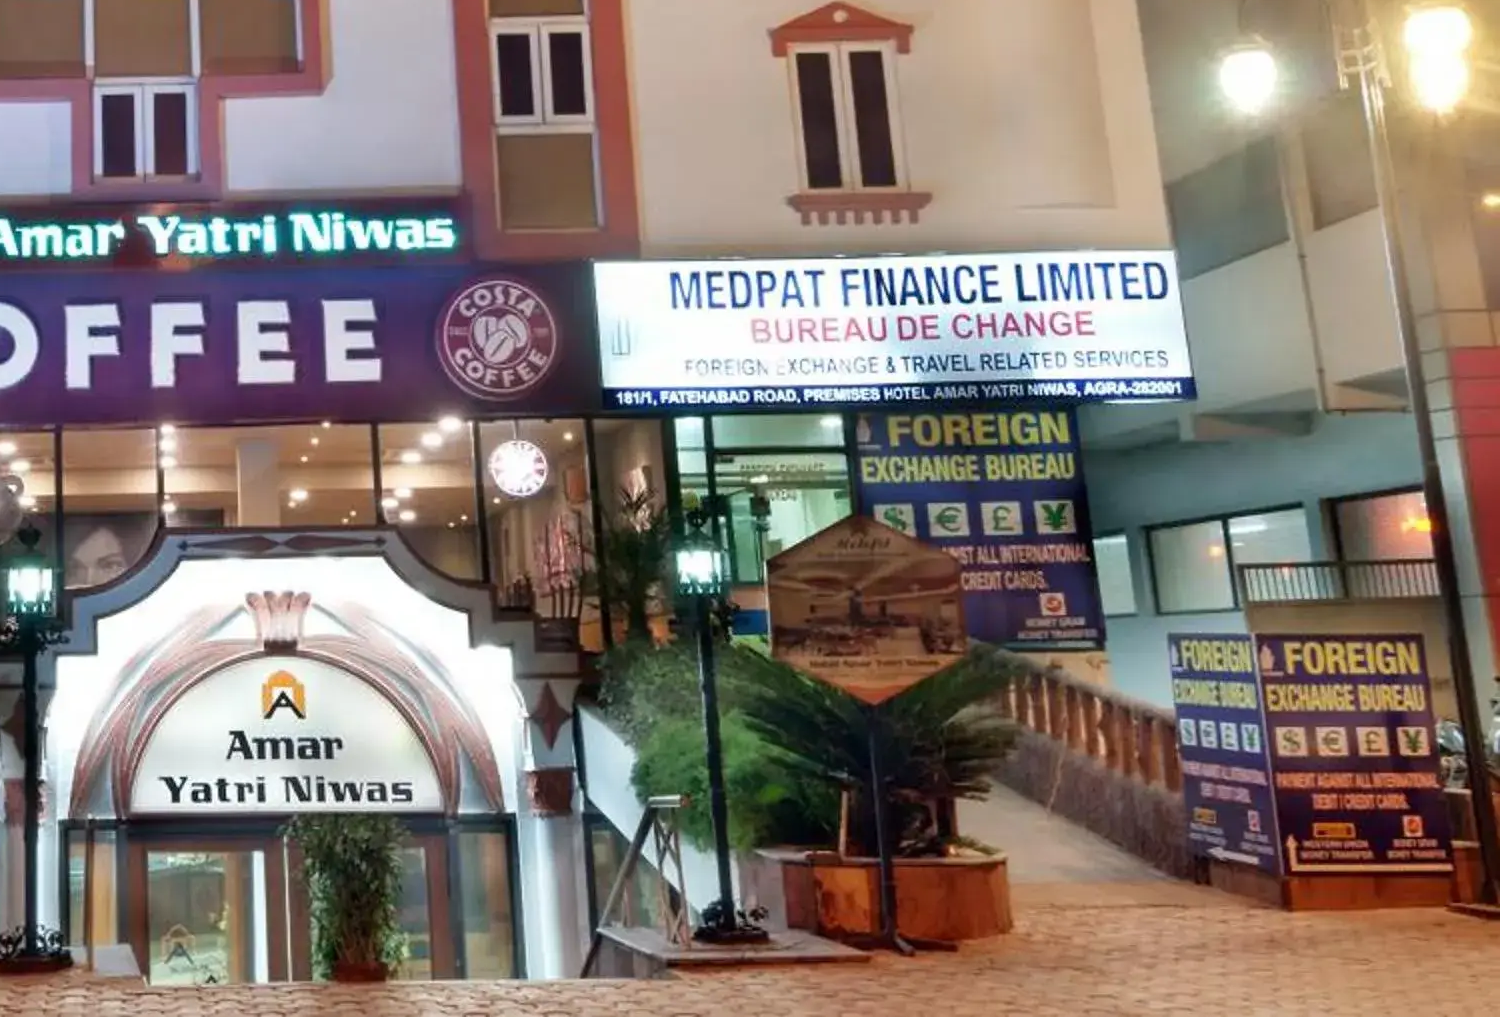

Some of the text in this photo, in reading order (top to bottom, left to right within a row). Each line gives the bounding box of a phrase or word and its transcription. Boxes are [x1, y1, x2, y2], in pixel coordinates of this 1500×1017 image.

[136, 214, 278, 255] Yatri
[289, 211, 457, 252] Niwas
[459, 285, 536, 318] COSTA
[669, 261, 1169, 310] MEDPAT FINANCE LIMITED
[750, 310, 1096, 344] BUREAU DE CHANGE
[454, 347, 548, 387] COFFEE
[685, 350, 1169, 377] FOREIGN EXCHANGE & TRAVEL RELATED SERVICES
[660, 389, 750, 404] FATEHABAD
[804, 386, 880, 402] PREMISES
[883, 386, 927, 401] HOTEL
[933, 385, 979, 399] AMAR
[982, 384, 1025, 398] YATRI
[886, 411, 1071, 447] FOREIGN
[860, 454, 981, 483] EXCHANGE
[985, 451, 1076, 481] BUREAU
[961, 570, 1002, 590] CREDIT
[1180, 639, 1253, 673] FOREIGN
[1283, 641, 1421, 676] FOREIGN
[1265, 684, 1425, 712] EXCHANGE BUREAU
[226, 730, 344, 761] Amar
[159, 775, 414, 803] Yatri Niwas
